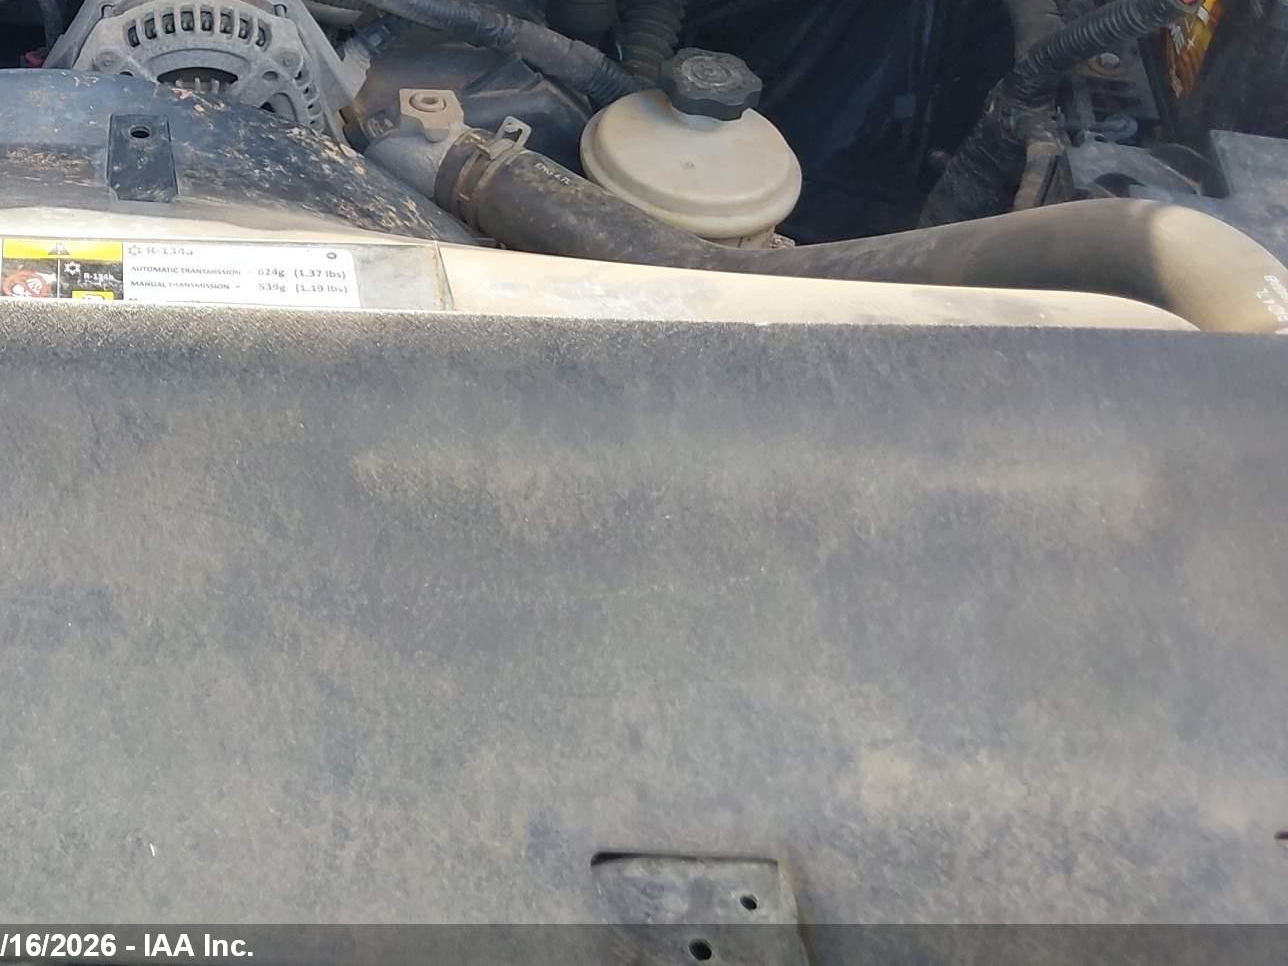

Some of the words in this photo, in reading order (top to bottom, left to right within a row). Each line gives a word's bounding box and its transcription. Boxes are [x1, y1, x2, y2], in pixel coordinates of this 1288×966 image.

[146, 246, 193, 256] R-134a
[131, 265, 179, 274] AUTOMATIC
[180, 267, 241, 275] TRANSMISSION
[130, 280, 167, 288] MANUAL
[168, 282, 231, 290] TRANSMISSION
